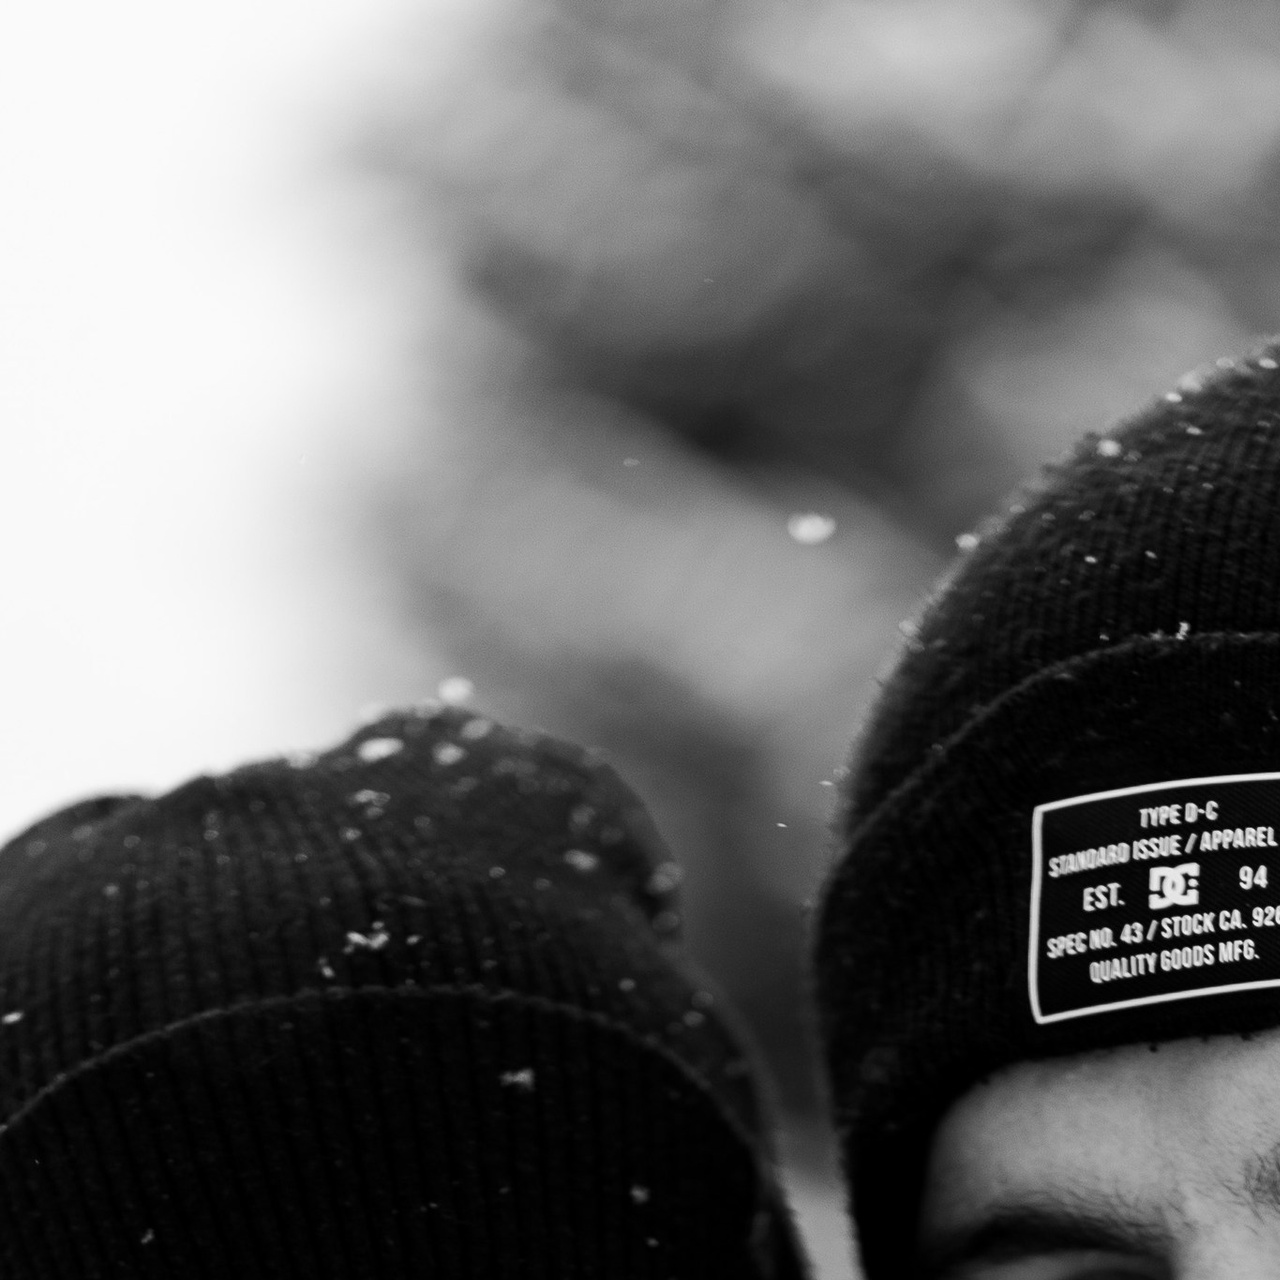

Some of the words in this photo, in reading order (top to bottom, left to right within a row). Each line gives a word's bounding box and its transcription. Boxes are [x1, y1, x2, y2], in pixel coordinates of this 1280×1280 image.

[1139, 804, 1182, 828] TYPE
[1184, 800, 1219, 823] D-C
[1048, 842, 1131, 878] STANDARD
[1132, 834, 1182, 860] ISSUE
[1200, 826, 1278, 852] APPAREL
[1083, 882, 1126, 912] EST.
[1239, 864, 1268, 890] 94
[1046, 931, 1088, 959] SPEC
[1089, 926, 1118, 951] NO.
[1120, 921, 1144, 944] 43
[1160, 911, 1216, 939] STOCK
[1219, 908, 1248, 931] CA.
[1089, 952, 1158, 984] QUALITY
[1160, 943, 1215, 972] GOODS
[1219, 938, 1260, 964] MFG.
